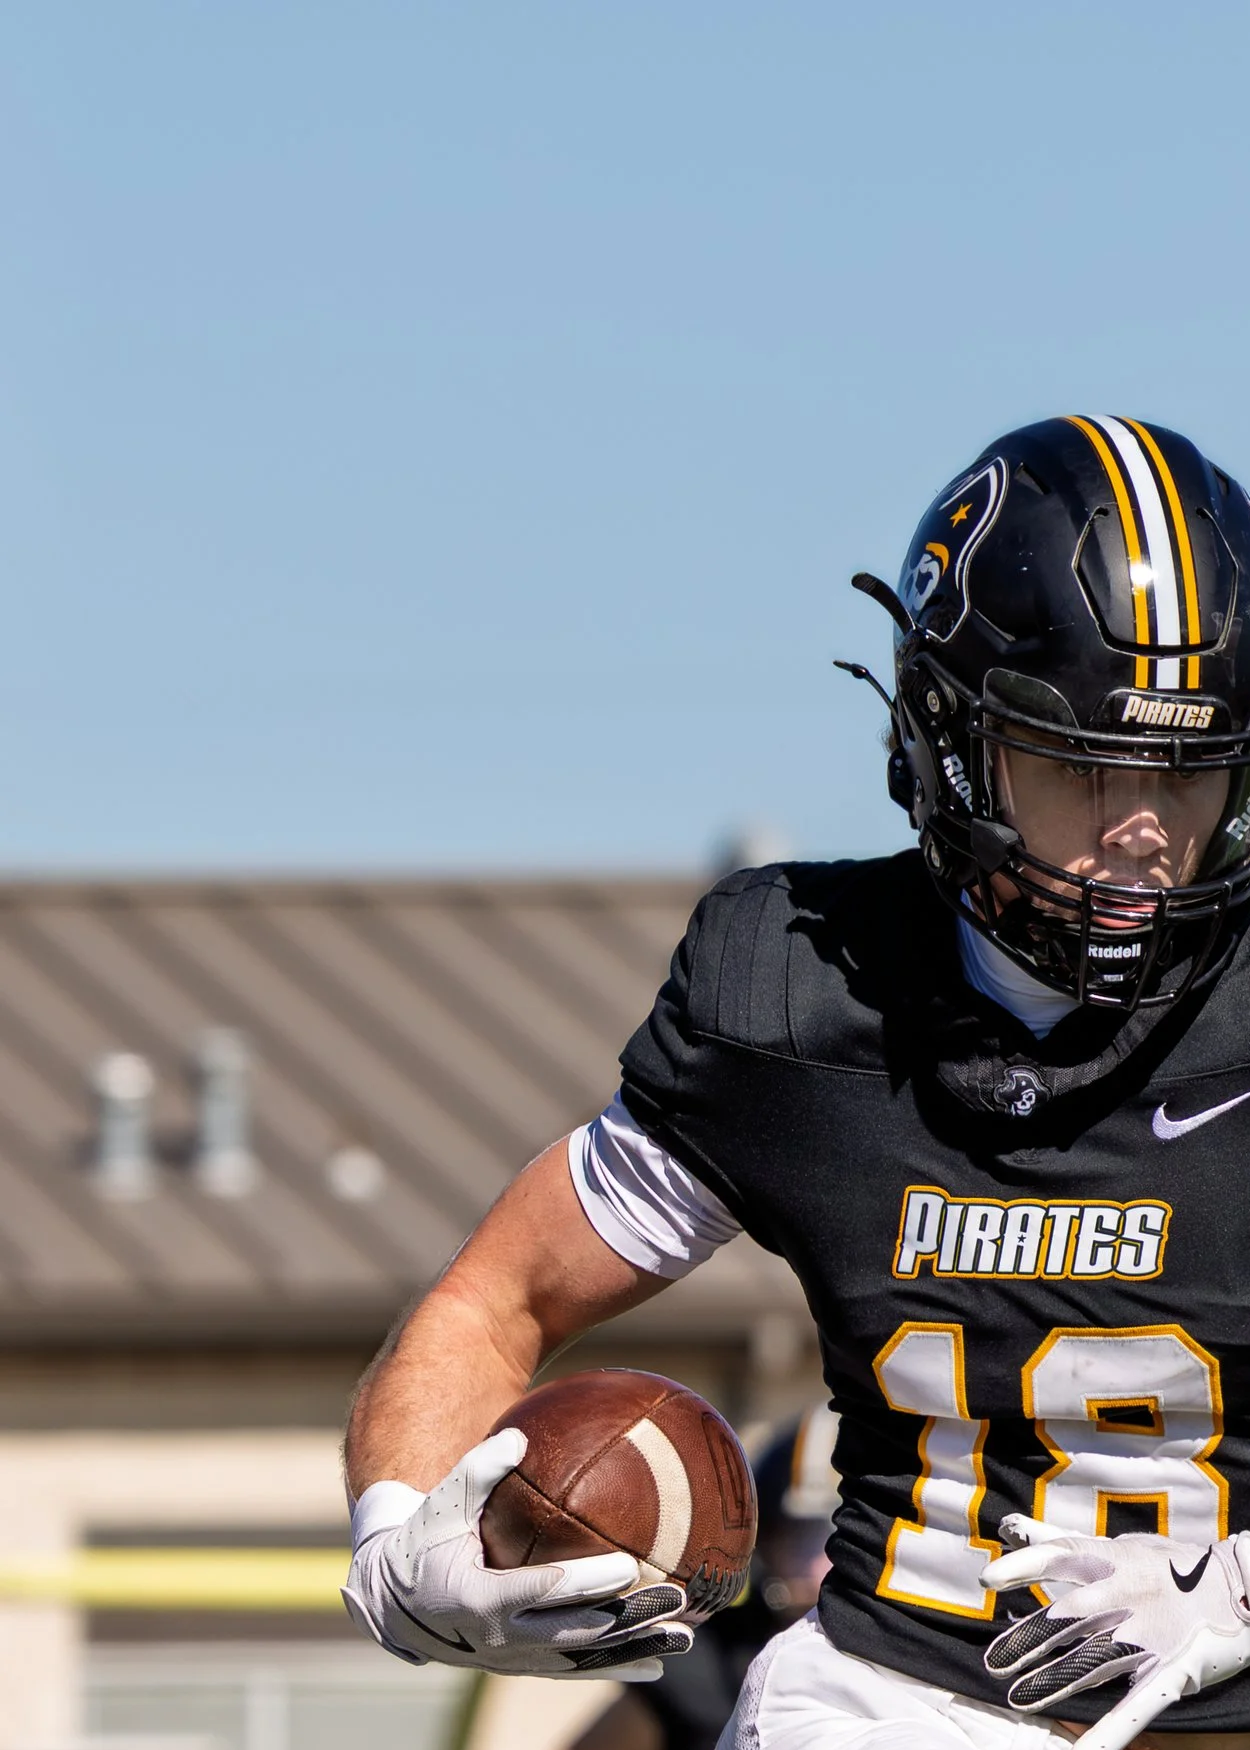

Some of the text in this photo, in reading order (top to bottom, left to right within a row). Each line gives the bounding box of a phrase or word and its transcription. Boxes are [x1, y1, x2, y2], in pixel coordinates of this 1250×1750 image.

[1121, 695, 1215, 729] PIRATES
[1088, 943, 1141, 958] Riddell
[892, 1185, 1172, 1280] PIRATES
[873, 1322, 1229, 1621] 18
